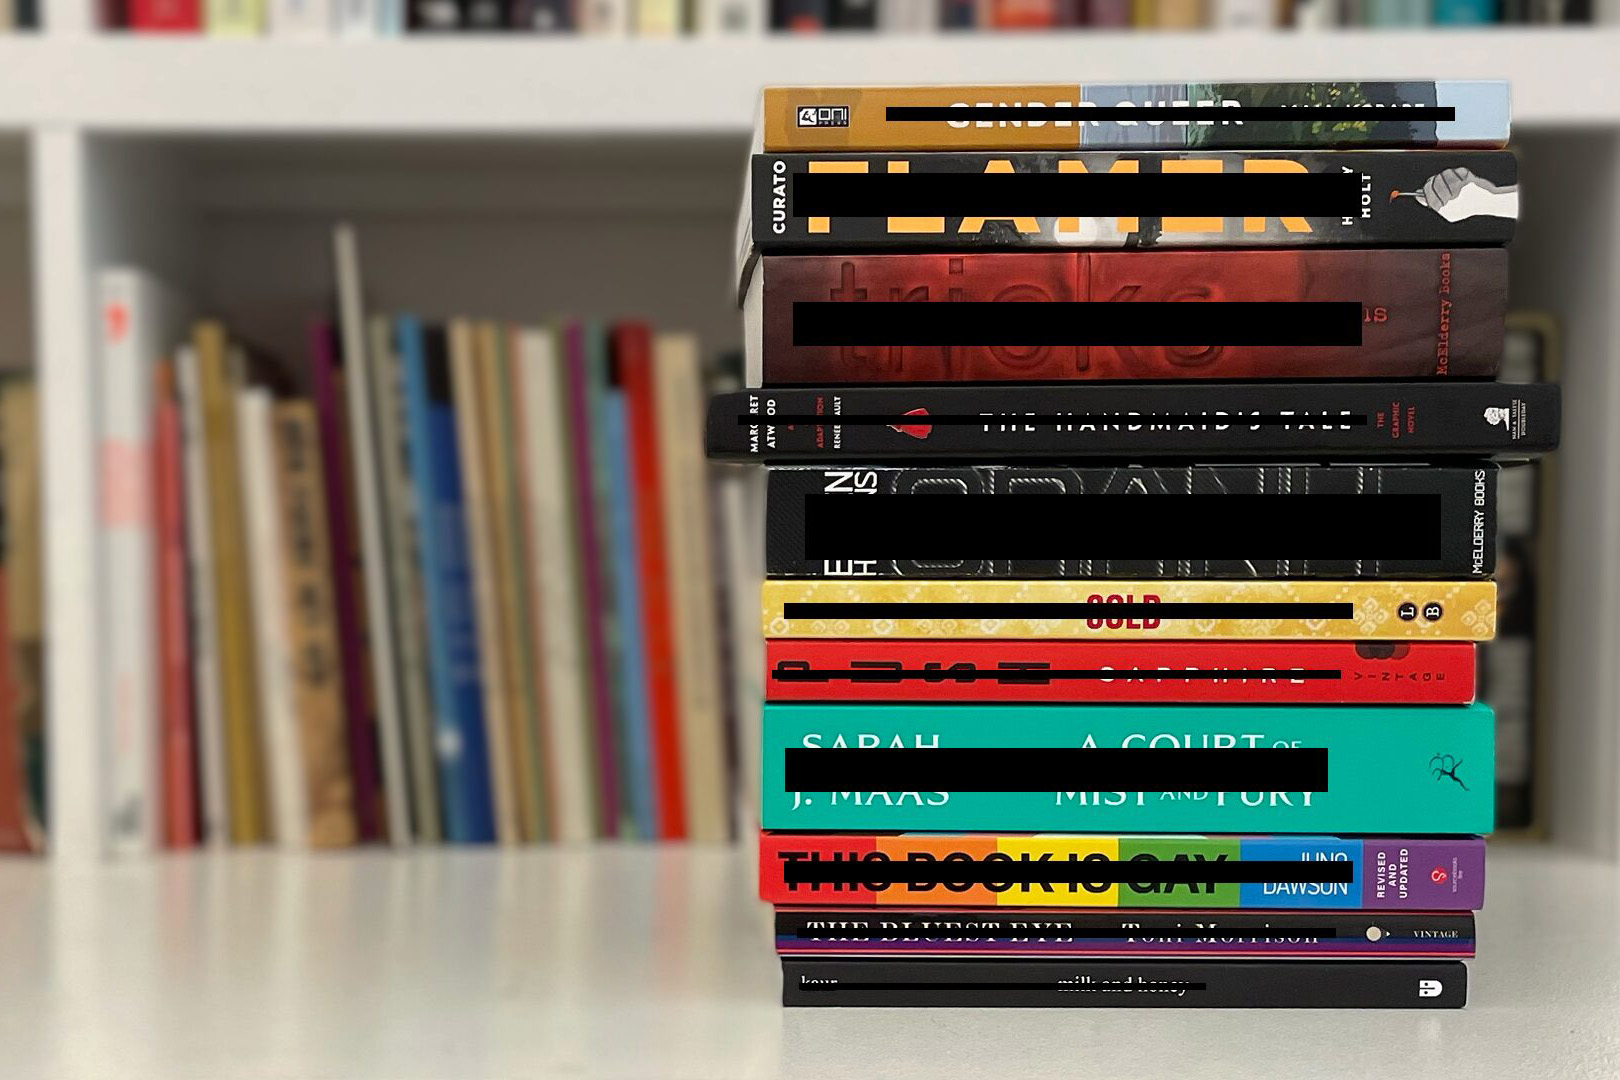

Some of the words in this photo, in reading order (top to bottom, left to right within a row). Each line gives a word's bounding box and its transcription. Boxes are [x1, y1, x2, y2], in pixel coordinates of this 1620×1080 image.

[773, 160, 787, 234] CURATO
[766, 399, 776, 449] ATWOD
[1376, 411, 1385, 429] THE
[1391, 401, 1400, 439] GRAPHIC
[1407, 405, 1416, 433] NOVEL
[1474, 470, 1485, 506] BOOKS
[1400, 607, 1414, 617] L
[1426, 606, 1440, 617] B
[1354, 672, 1445, 681] VINTAGE
[1376, 852, 1386, 898] REVISED
[1388, 863, 1397, 887] AND
[1399, 848, 1408, 899] UPDATED
[1413, 930, 1459, 938] VINTAGE
